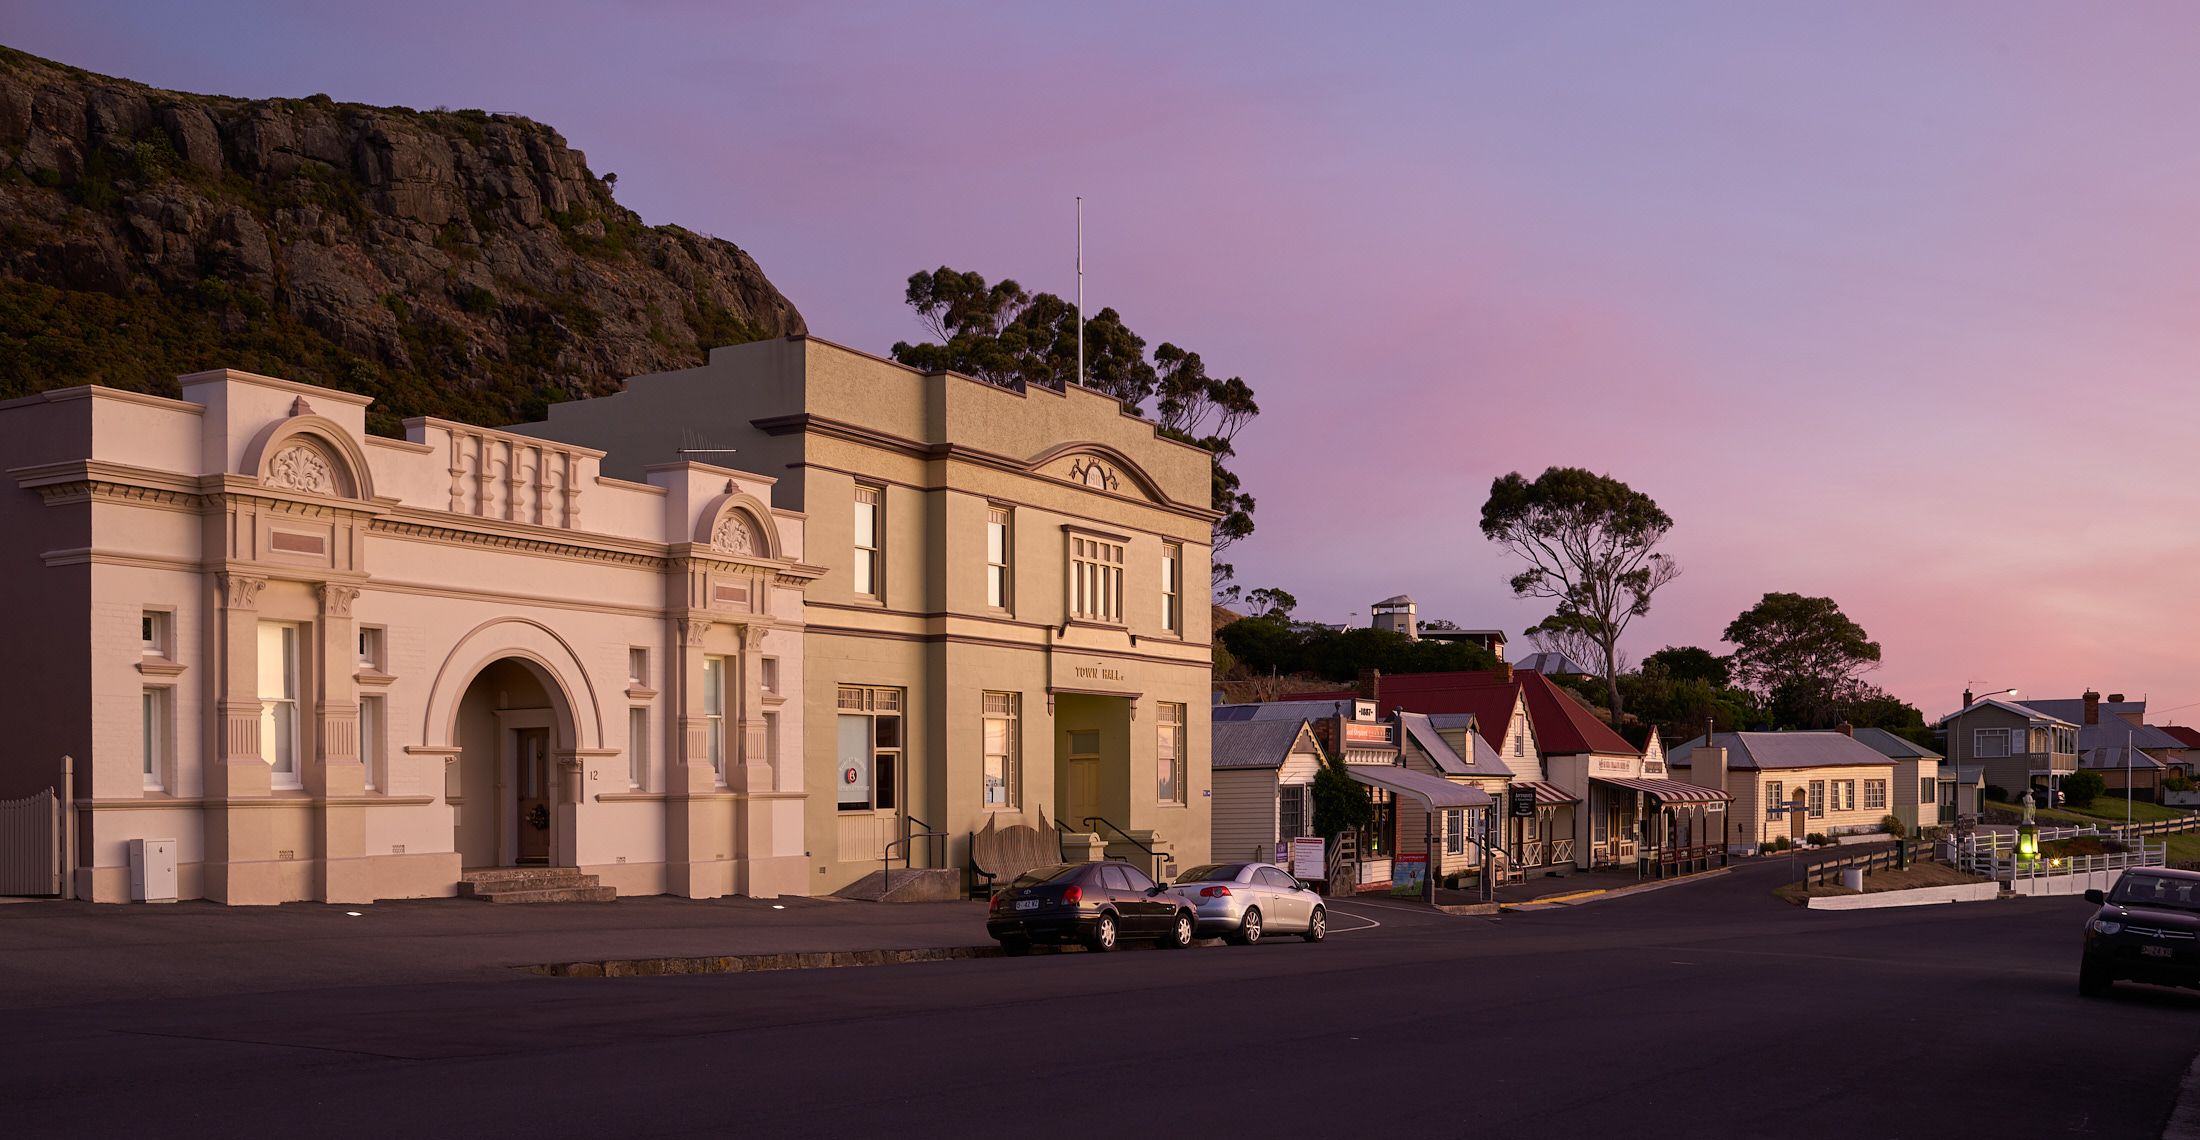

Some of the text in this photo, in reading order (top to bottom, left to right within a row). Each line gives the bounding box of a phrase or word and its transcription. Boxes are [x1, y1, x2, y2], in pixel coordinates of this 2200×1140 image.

[1075, 666, 1120, 680] TOWN HALL
[590, 770, 598, 780] 12
